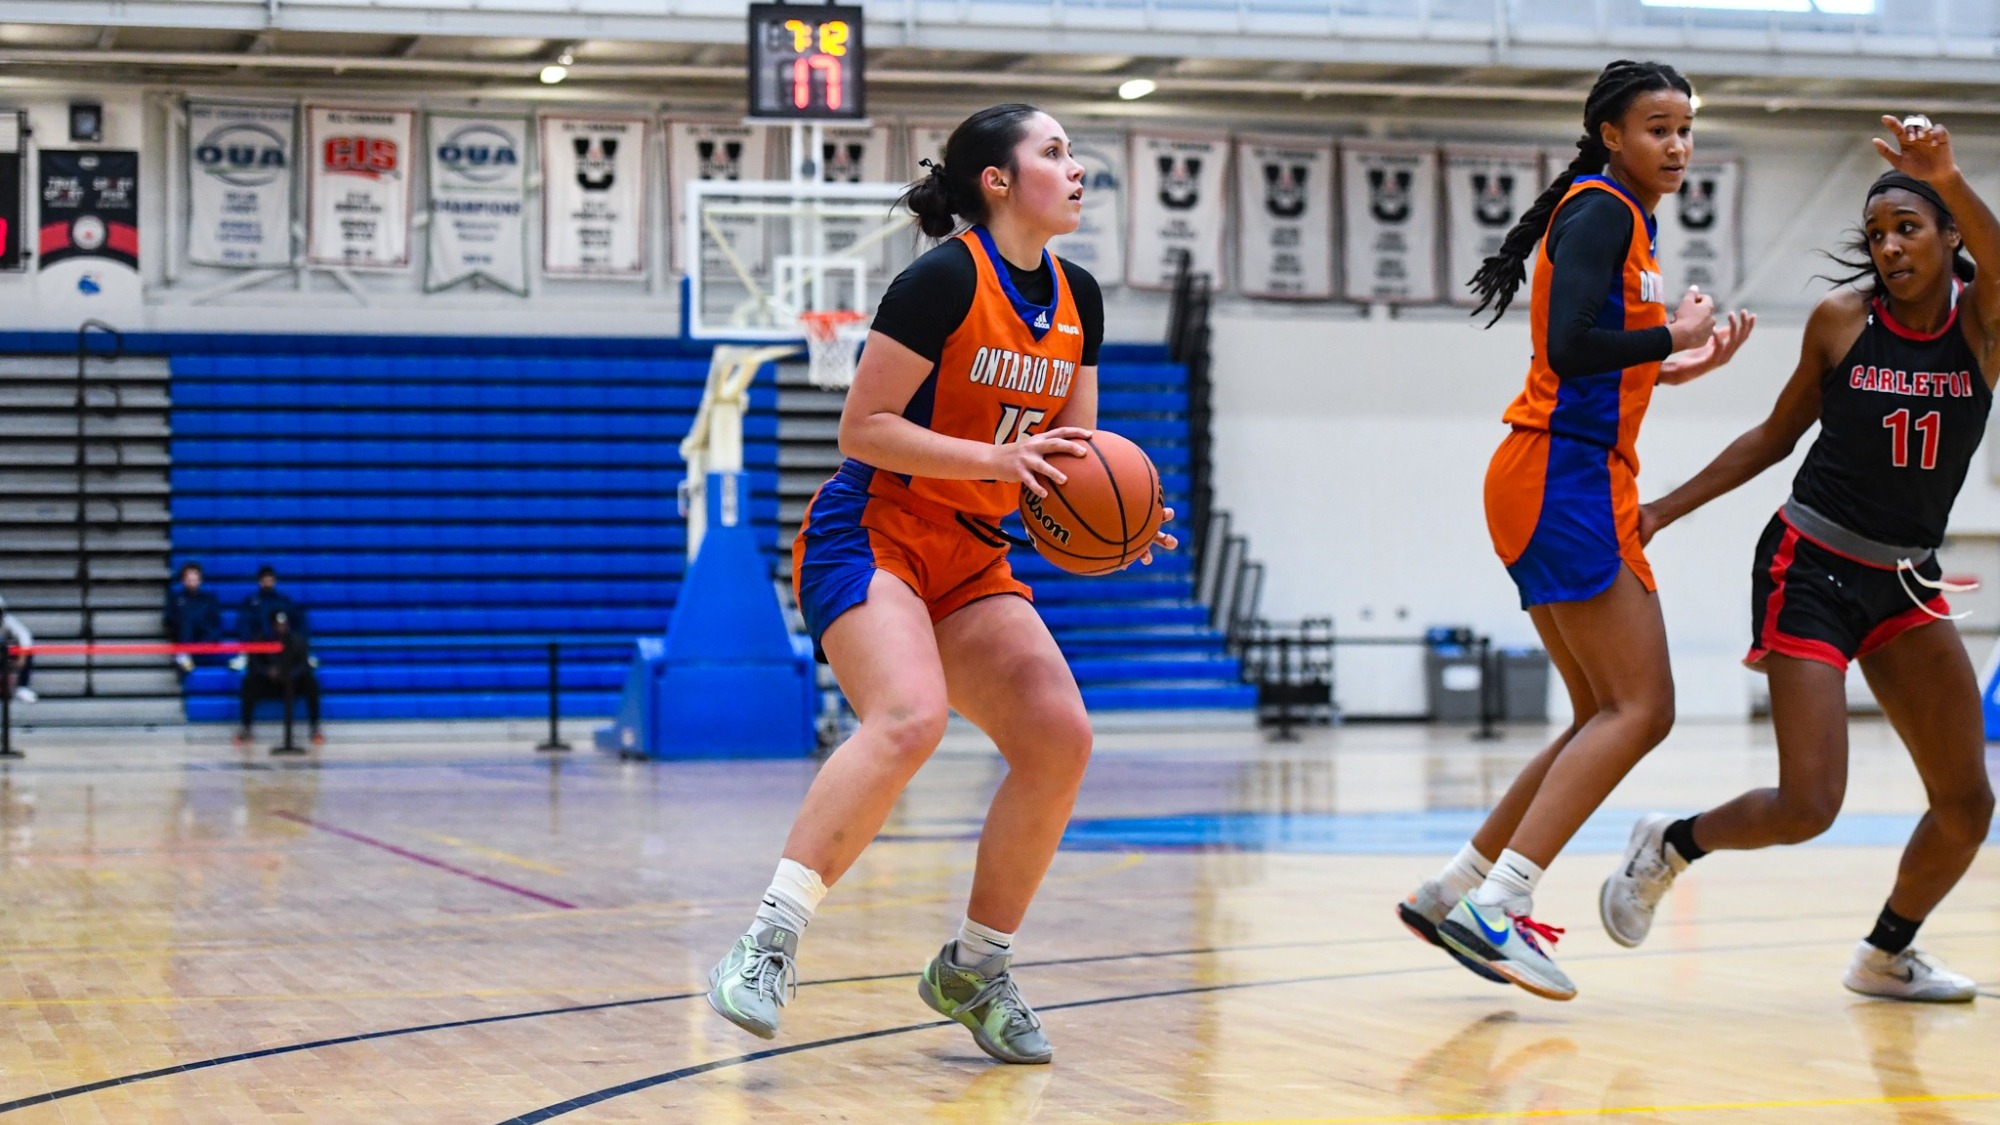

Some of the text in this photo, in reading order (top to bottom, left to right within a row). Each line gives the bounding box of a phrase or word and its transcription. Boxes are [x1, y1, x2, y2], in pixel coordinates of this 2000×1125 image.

[785, 19, 849, 57] 7:12
[794, 53, 841, 110] 17
[196, 144, 287, 168] OUA
[323, 135, 398, 171] CIS
[436, 143, 518, 166] OUA
[1033, 321, 1050, 329] adidas
[969, 346, 1048, 394] ONTARIO
[1882, 407, 1941, 470] 11
